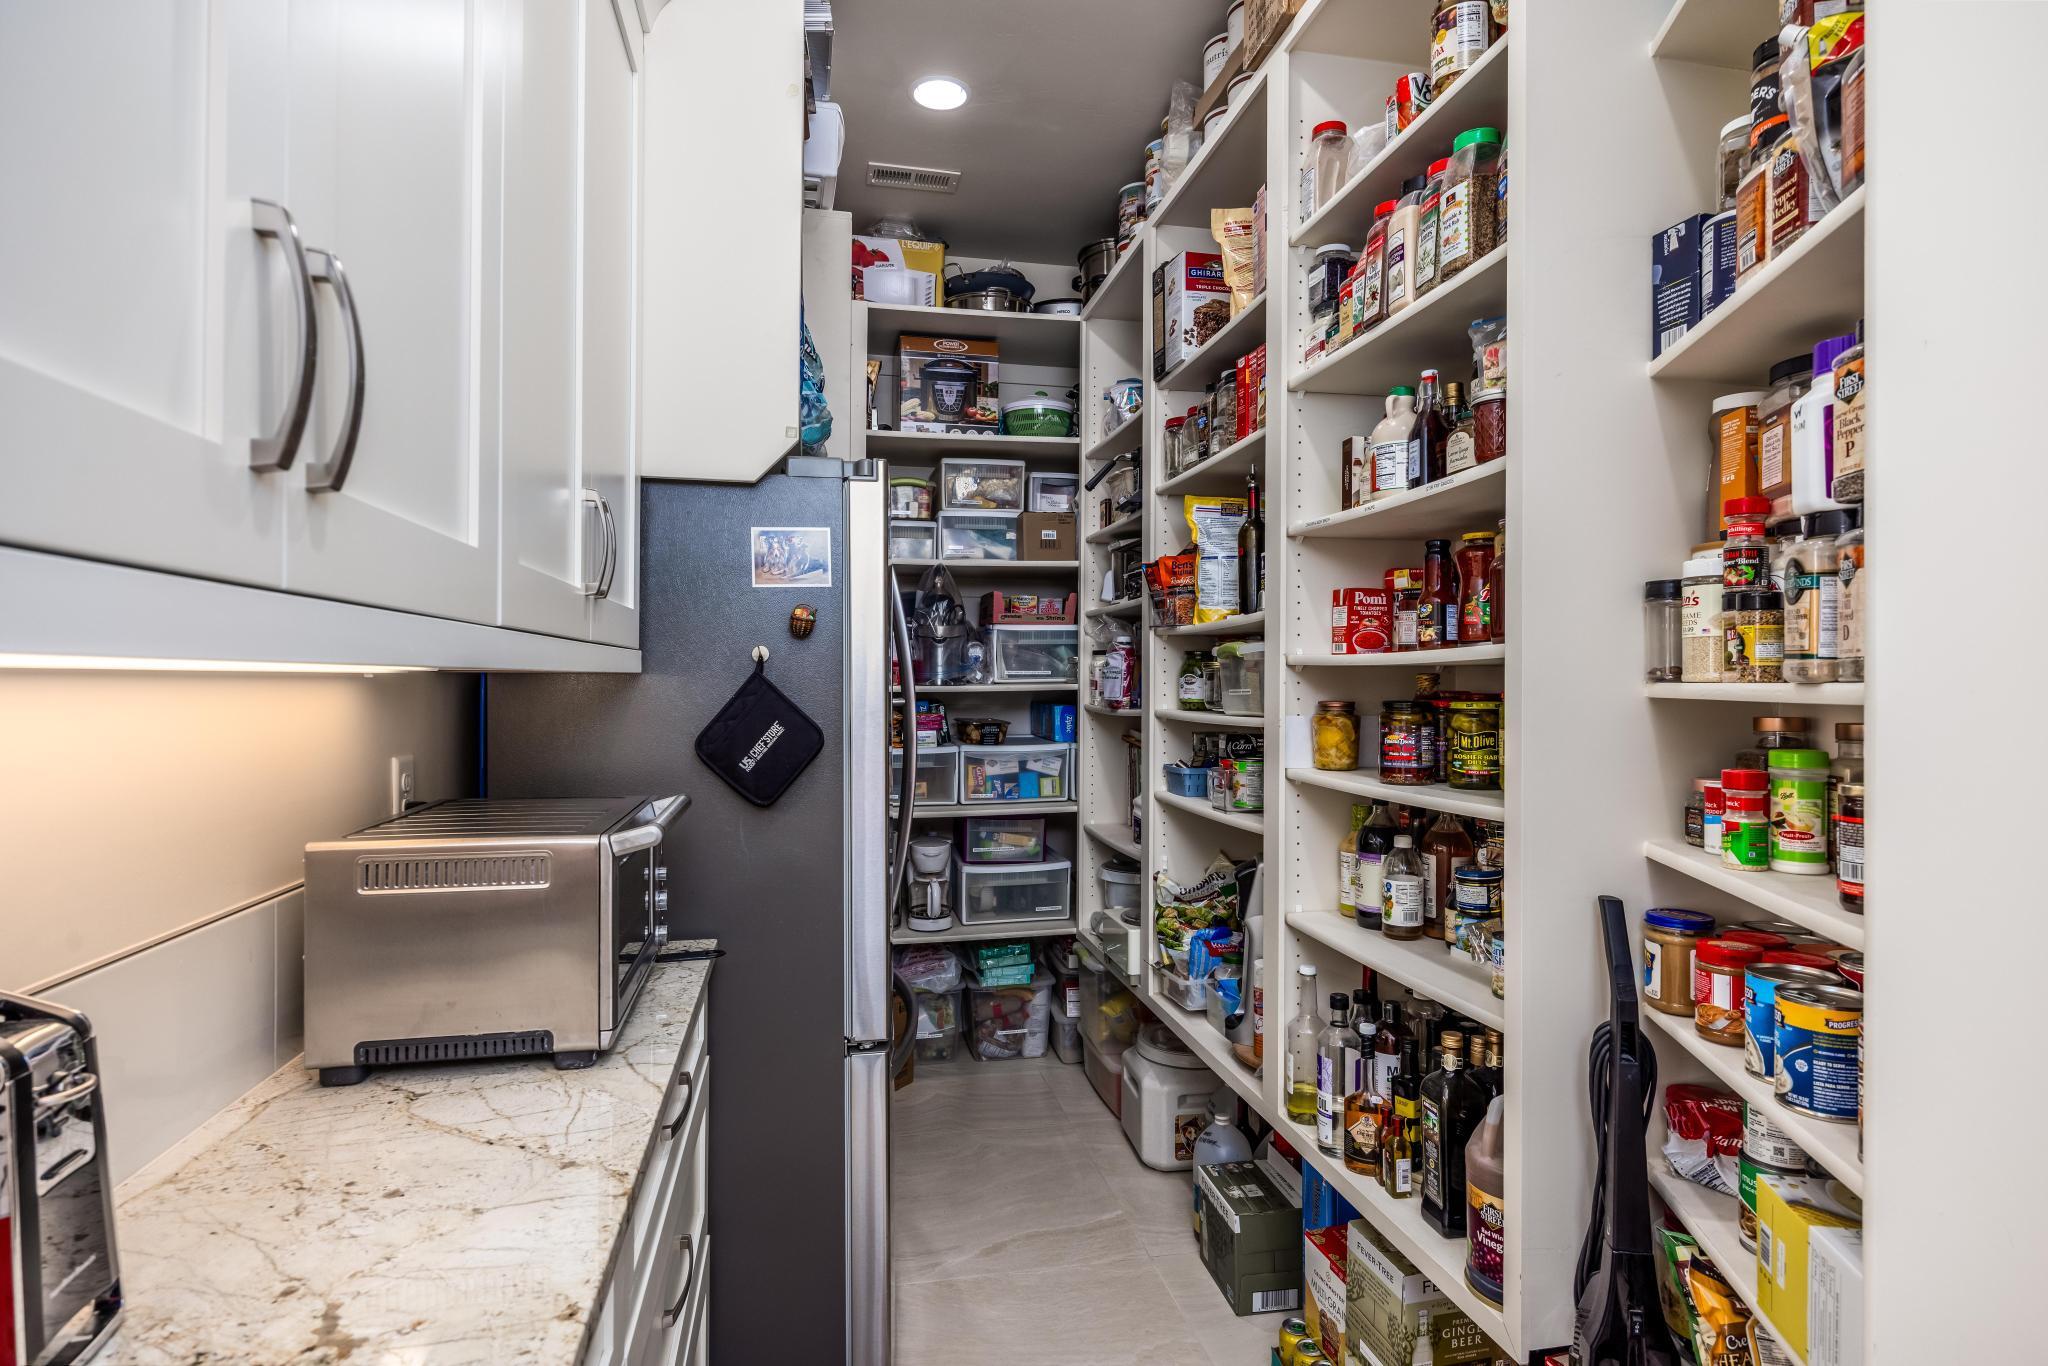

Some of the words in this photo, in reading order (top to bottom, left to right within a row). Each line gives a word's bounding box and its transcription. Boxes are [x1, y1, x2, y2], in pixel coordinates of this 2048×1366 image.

[1206, 48, 1229, 65] nutris
[1839, 372, 1860, 389] FIRST
[1836, 380, 1864, 400] STREET
[1839, 415, 1861, 429] Black
[1836, 424, 1864, 441] Pepper
[1845, 441, 1855, 458] P
[1354, 592, 1387, 605] Pomì
[1065, 713, 1073, 734] Ziploc
[1461, 735, 1472, 749] Mt.
[1473, 734, 1495, 747] Olive
[1828, 1020, 1857, 1029] PROGRES
[1483, 1204, 1502, 1219] FIRST
[1477, 1230, 1504, 1254] Vineg
[1491, 1231, 1504, 1242] Win
[1356, 1241, 1394, 1284] FEVER-TREE
[1452, 1316, 1472, 1326] PREMI
[1451, 1334, 1482, 1349] BEER
